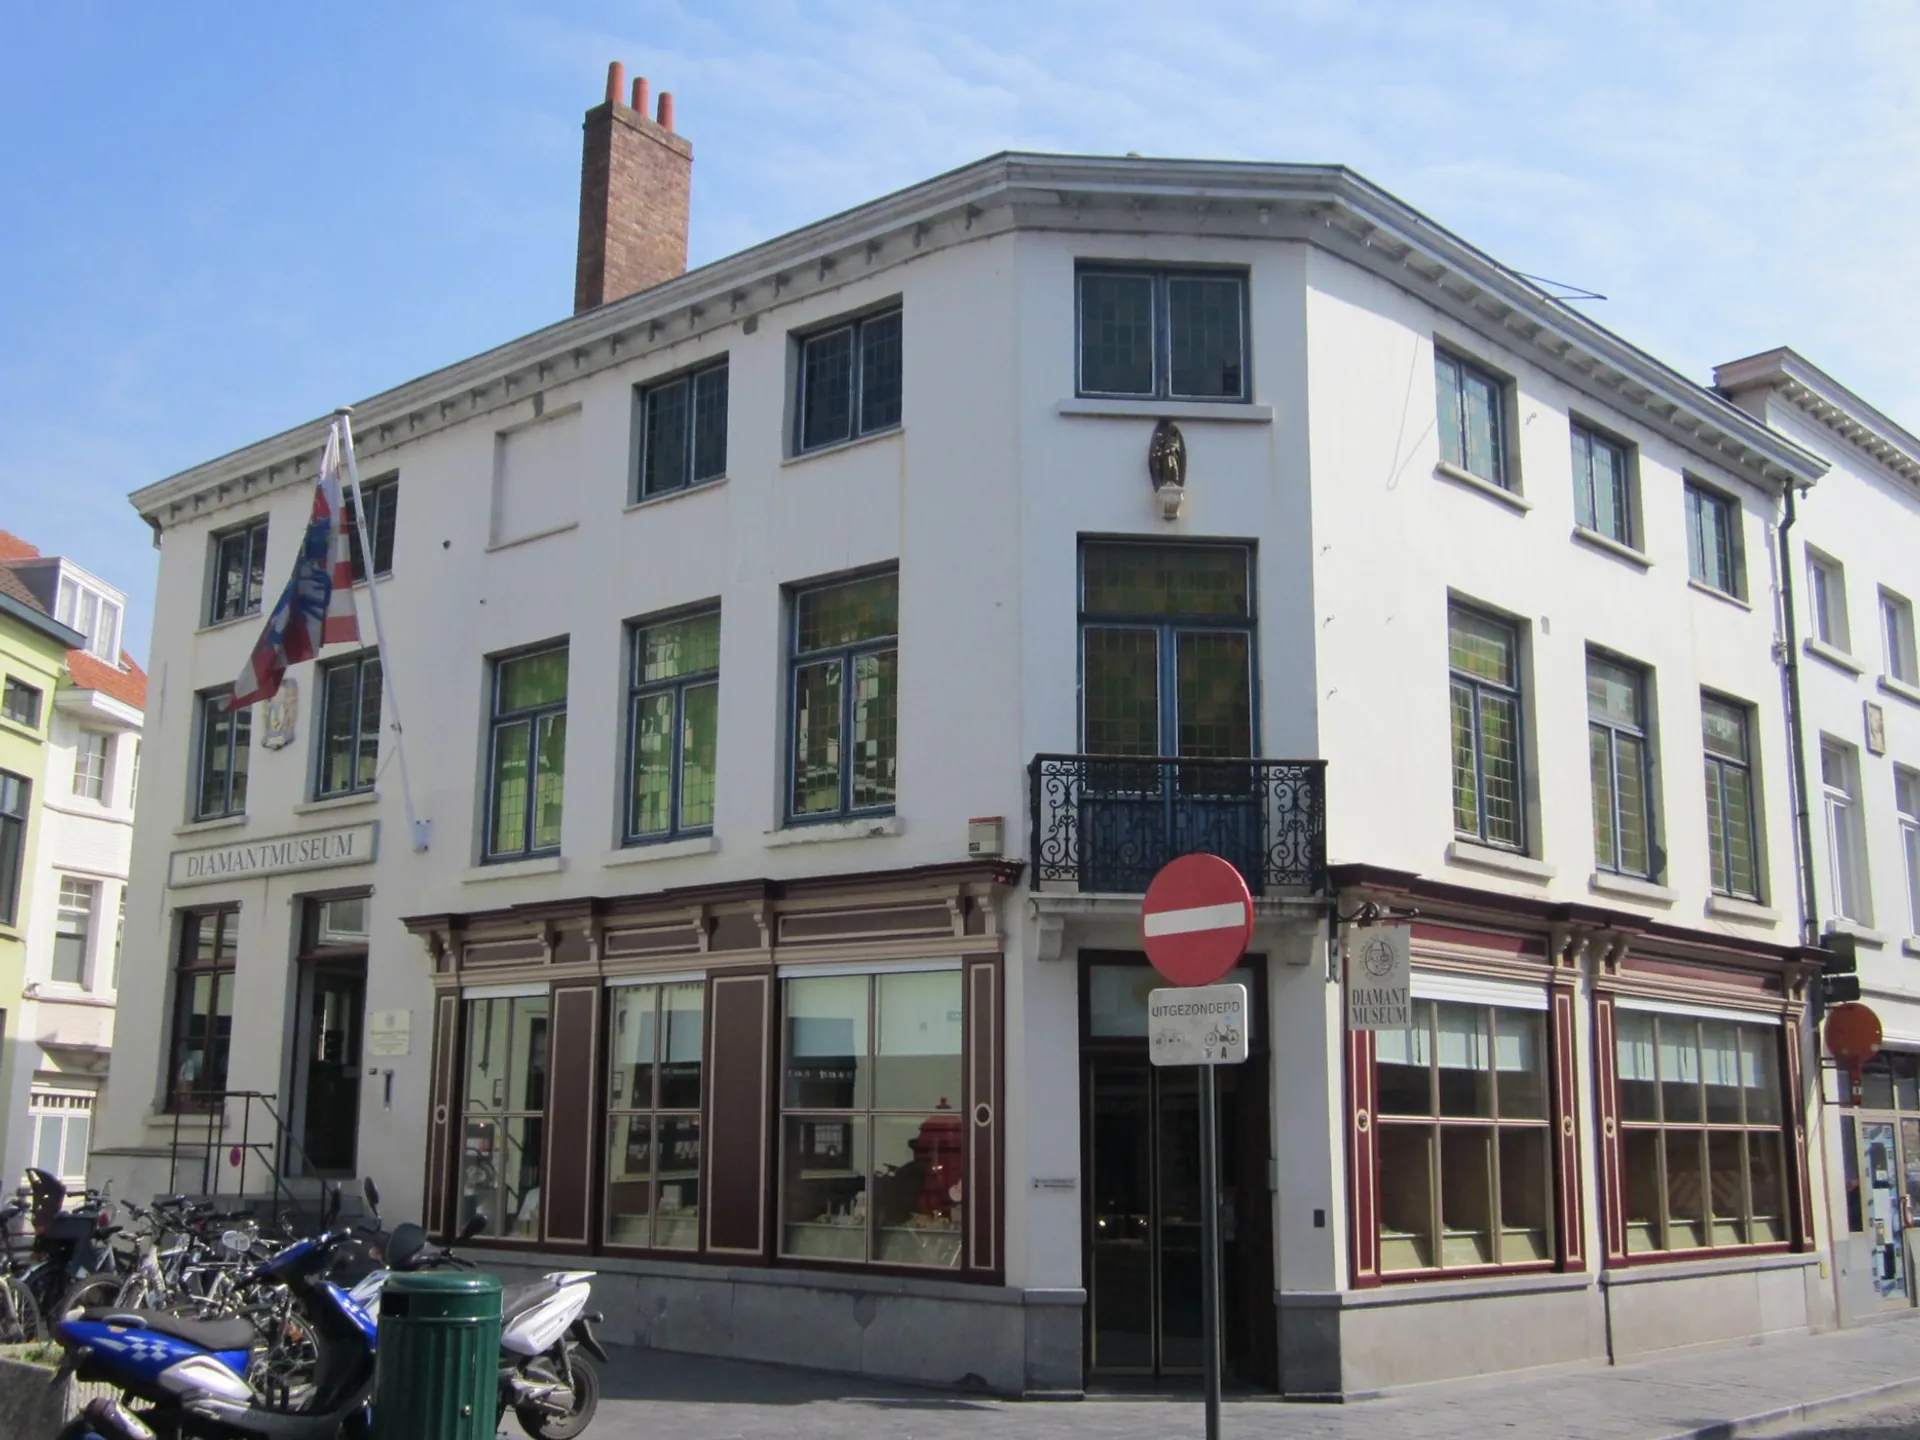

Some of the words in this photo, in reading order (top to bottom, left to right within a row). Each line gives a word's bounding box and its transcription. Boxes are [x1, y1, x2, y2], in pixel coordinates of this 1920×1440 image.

[187, 833, 354, 878] DIAMANTMUSEUM
[1352, 987, 1407, 1006] DIAMANT
[1352, 1006, 1407, 1025] MUSEUM
